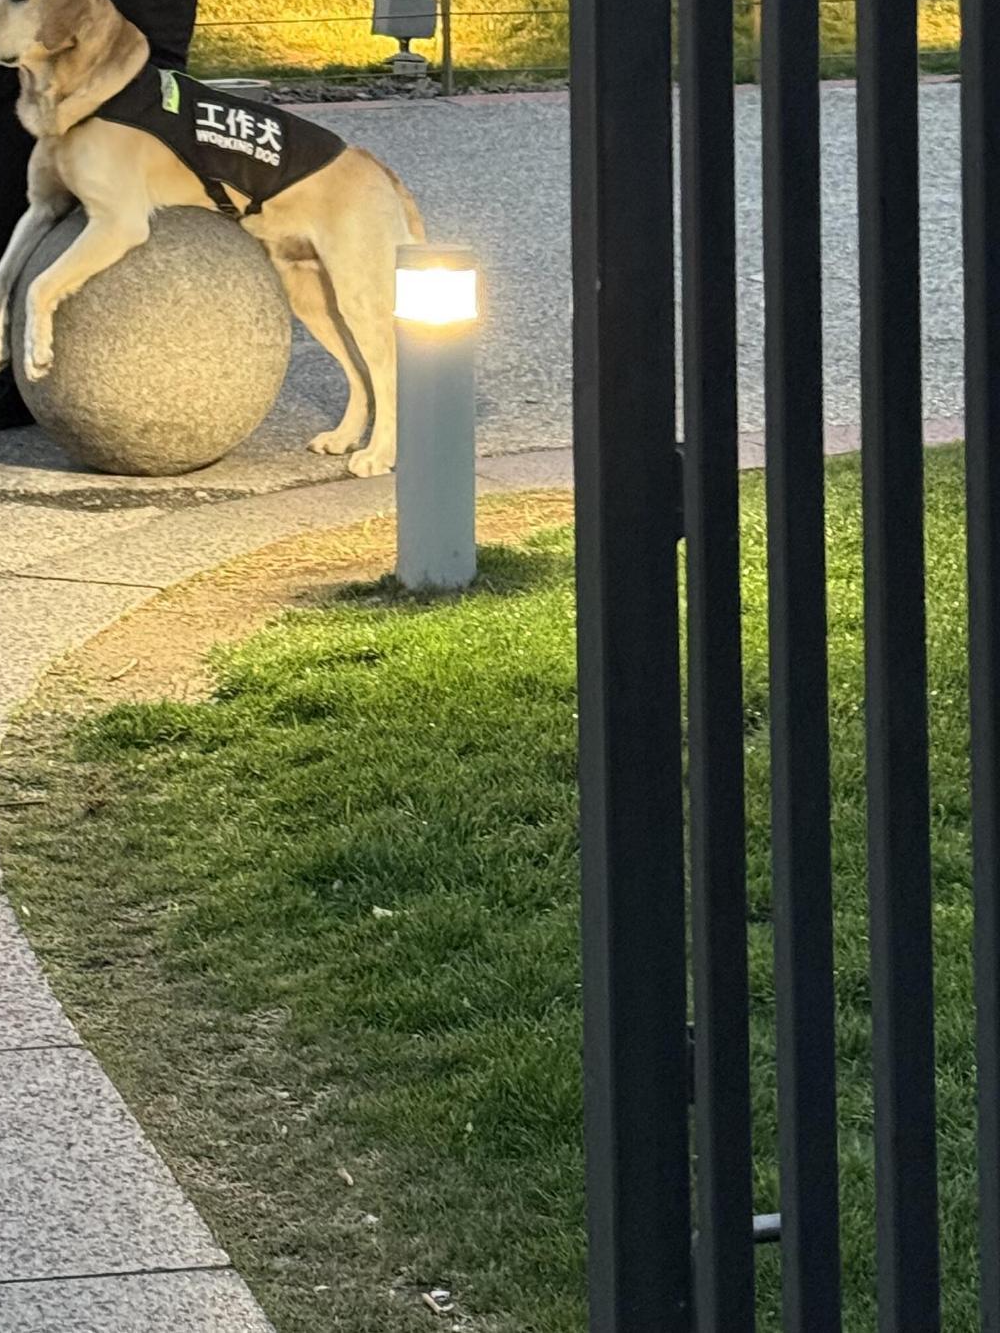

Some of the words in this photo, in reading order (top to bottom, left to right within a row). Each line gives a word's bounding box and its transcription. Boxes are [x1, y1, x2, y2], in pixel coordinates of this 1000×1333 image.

[195, 101, 283, 152] 工作犬
[195, 128, 255, 156] WORKING
[254, 146, 281, 167] DOG
